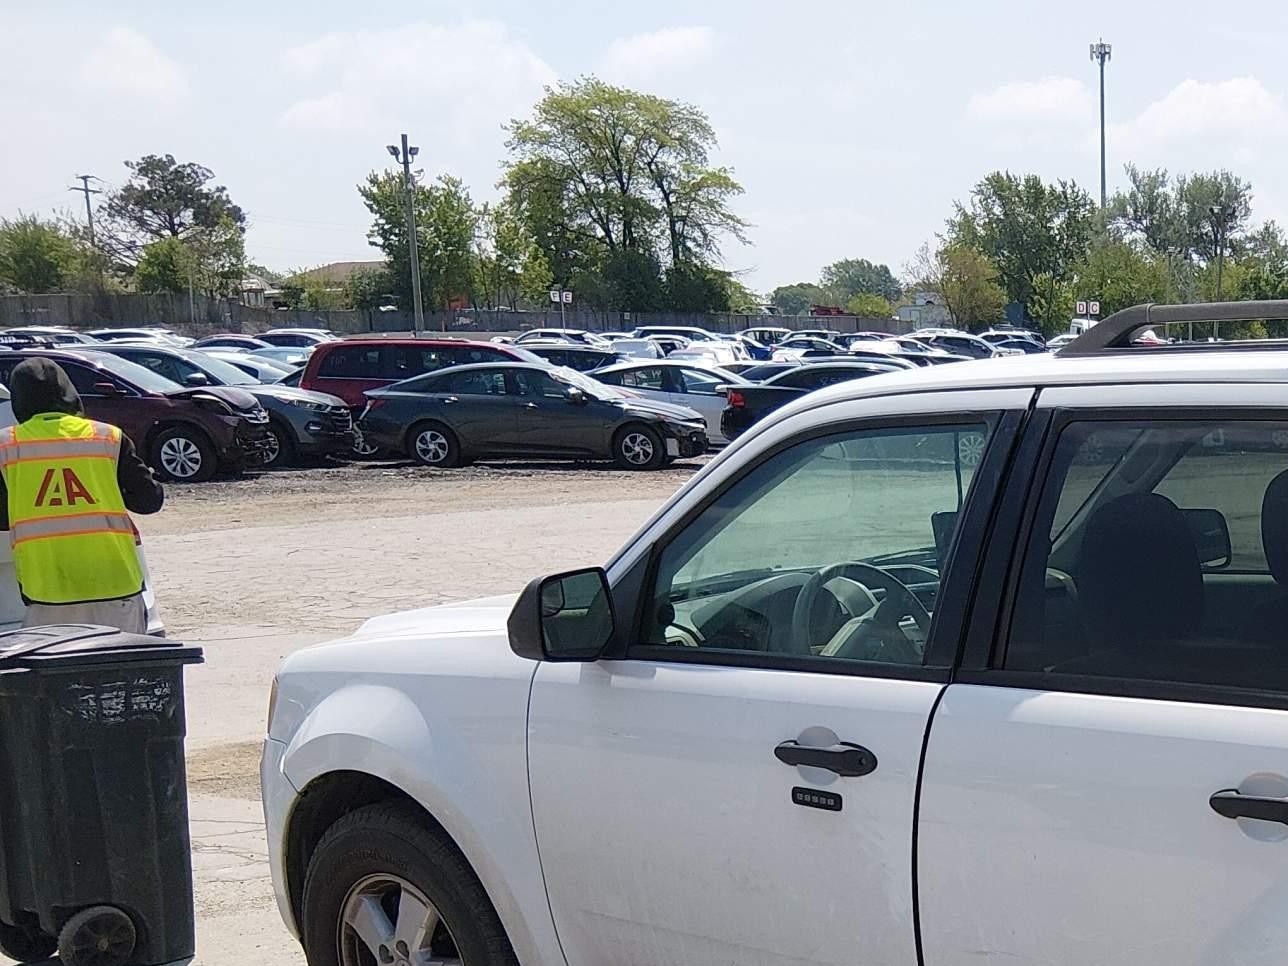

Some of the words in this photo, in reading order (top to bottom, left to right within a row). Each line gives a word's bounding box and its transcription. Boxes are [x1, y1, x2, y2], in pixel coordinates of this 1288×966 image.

[565, 293, 571, 302] E
[1078, 303, 1085, 313] D
[1091, 303, 1098, 313] C
